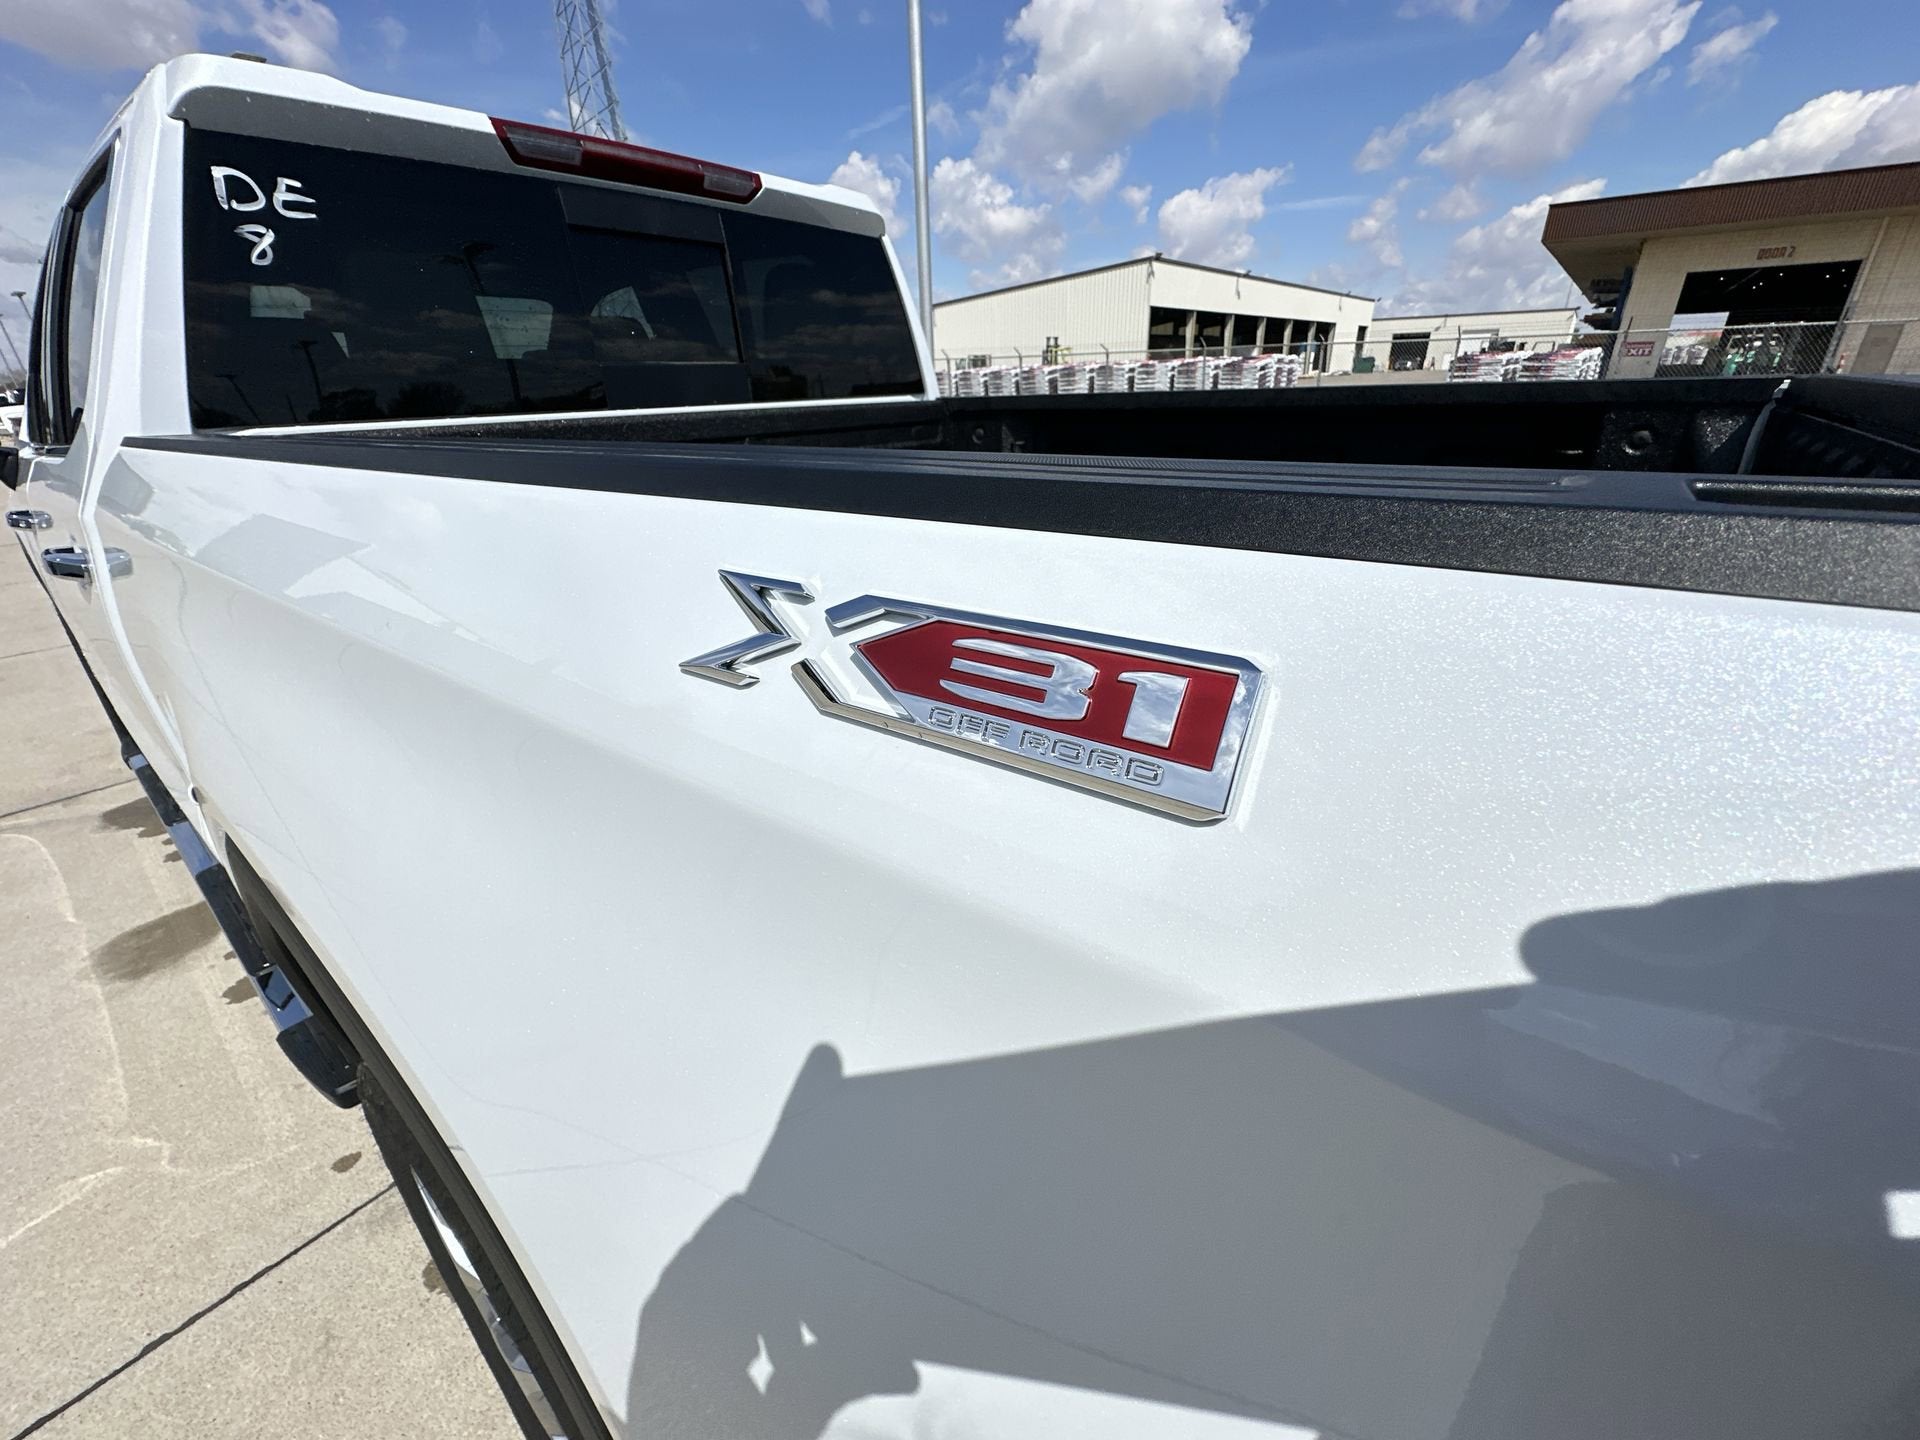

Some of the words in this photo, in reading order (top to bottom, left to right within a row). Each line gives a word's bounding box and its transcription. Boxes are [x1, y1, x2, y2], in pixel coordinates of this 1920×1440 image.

[210, 165, 318, 219] DE
[233, 223, 275, 266] 8
[927, 705, 1011, 743] OFF
[1018, 728, 1165, 787] ROAD
